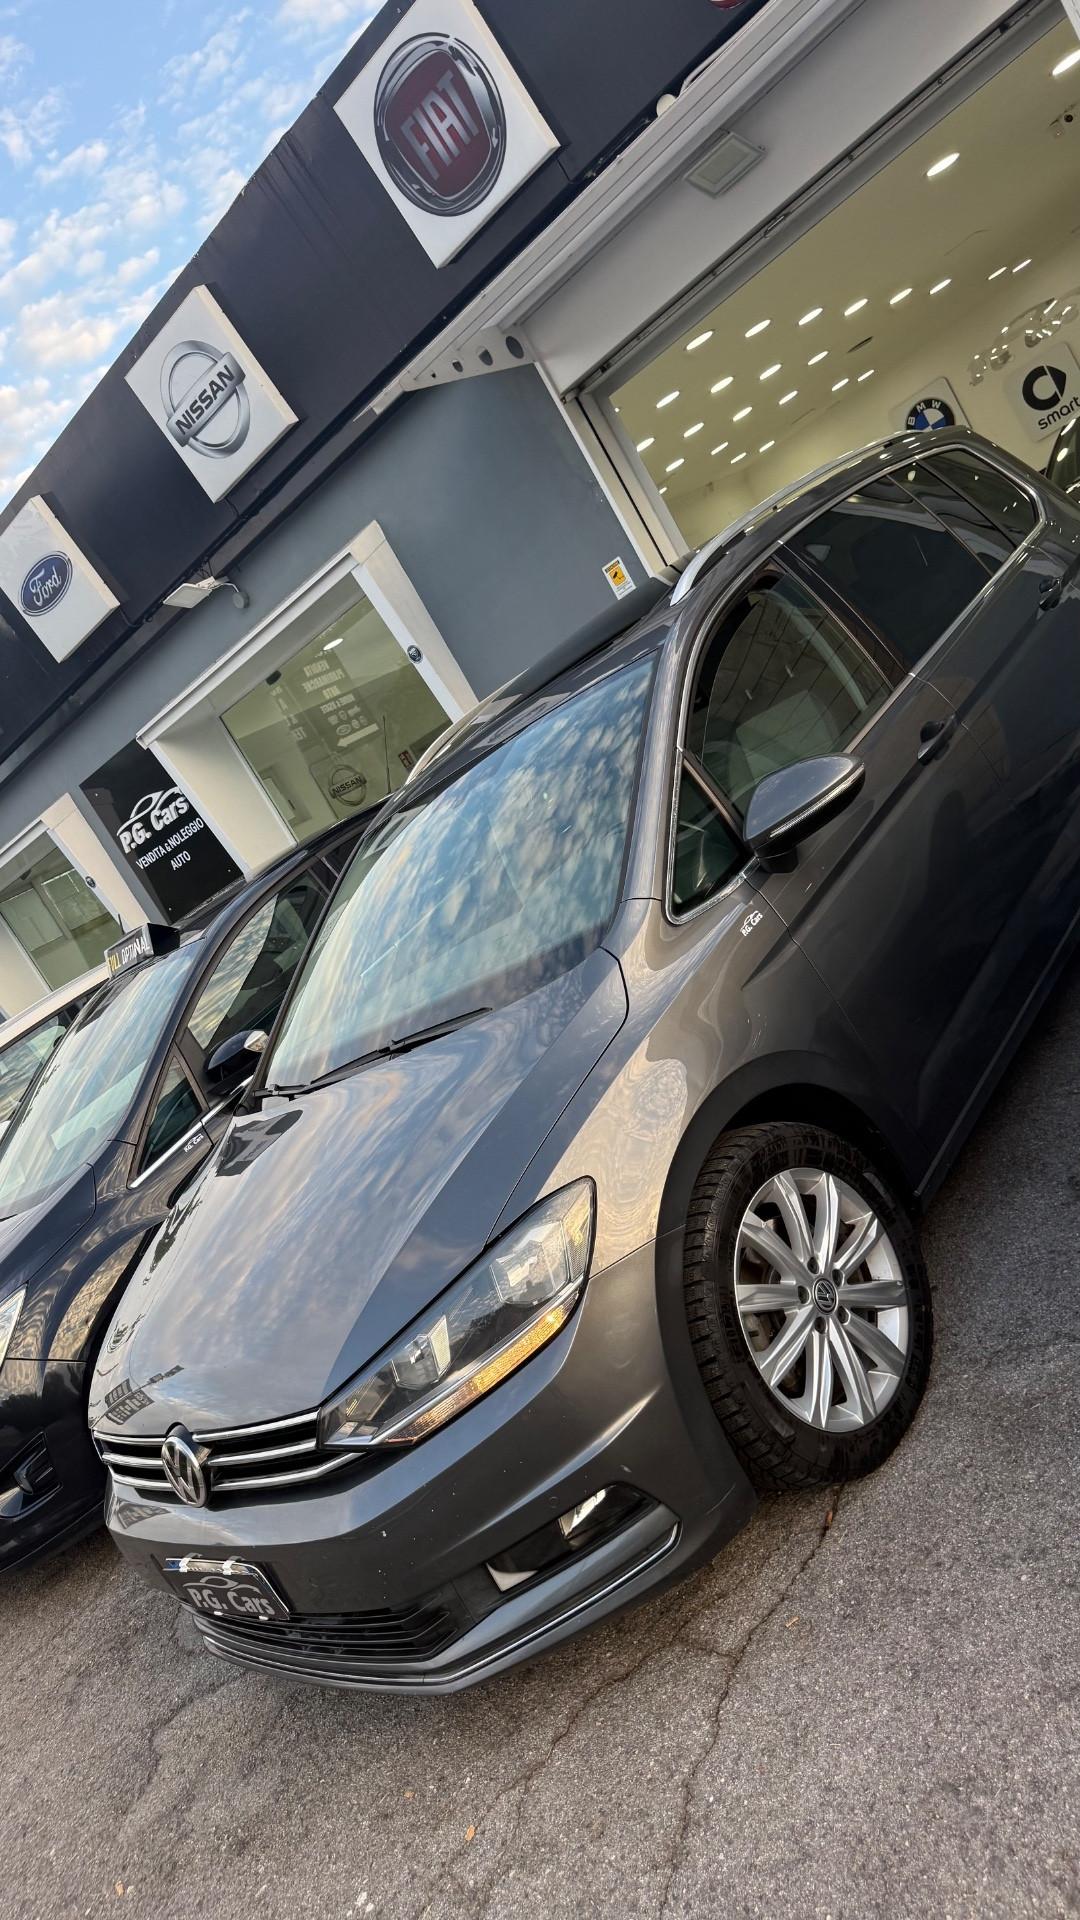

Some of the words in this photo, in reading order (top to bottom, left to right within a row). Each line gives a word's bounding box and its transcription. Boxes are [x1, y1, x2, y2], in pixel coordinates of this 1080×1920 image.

[400, 69, 479, 181] FIAT
[175, 364, 235, 435] NISSAN
[907, 399, 942, 426] BMW
[1038, 396, 1080, 430] smart
[29, 565, 62, 607] Ford
[331, 775, 362, 795] NISSAN
[120, 822, 152, 854] P.G.
[151, 796, 189, 831] Cars
[136, 845, 168, 869] VENDITA
[167, 817, 204, 849] NOLEGGIO
[170, 850, 191, 870] AUTO
[187, 1588, 229, 1610] P.G.
[226, 1591, 275, 1615] Cars
